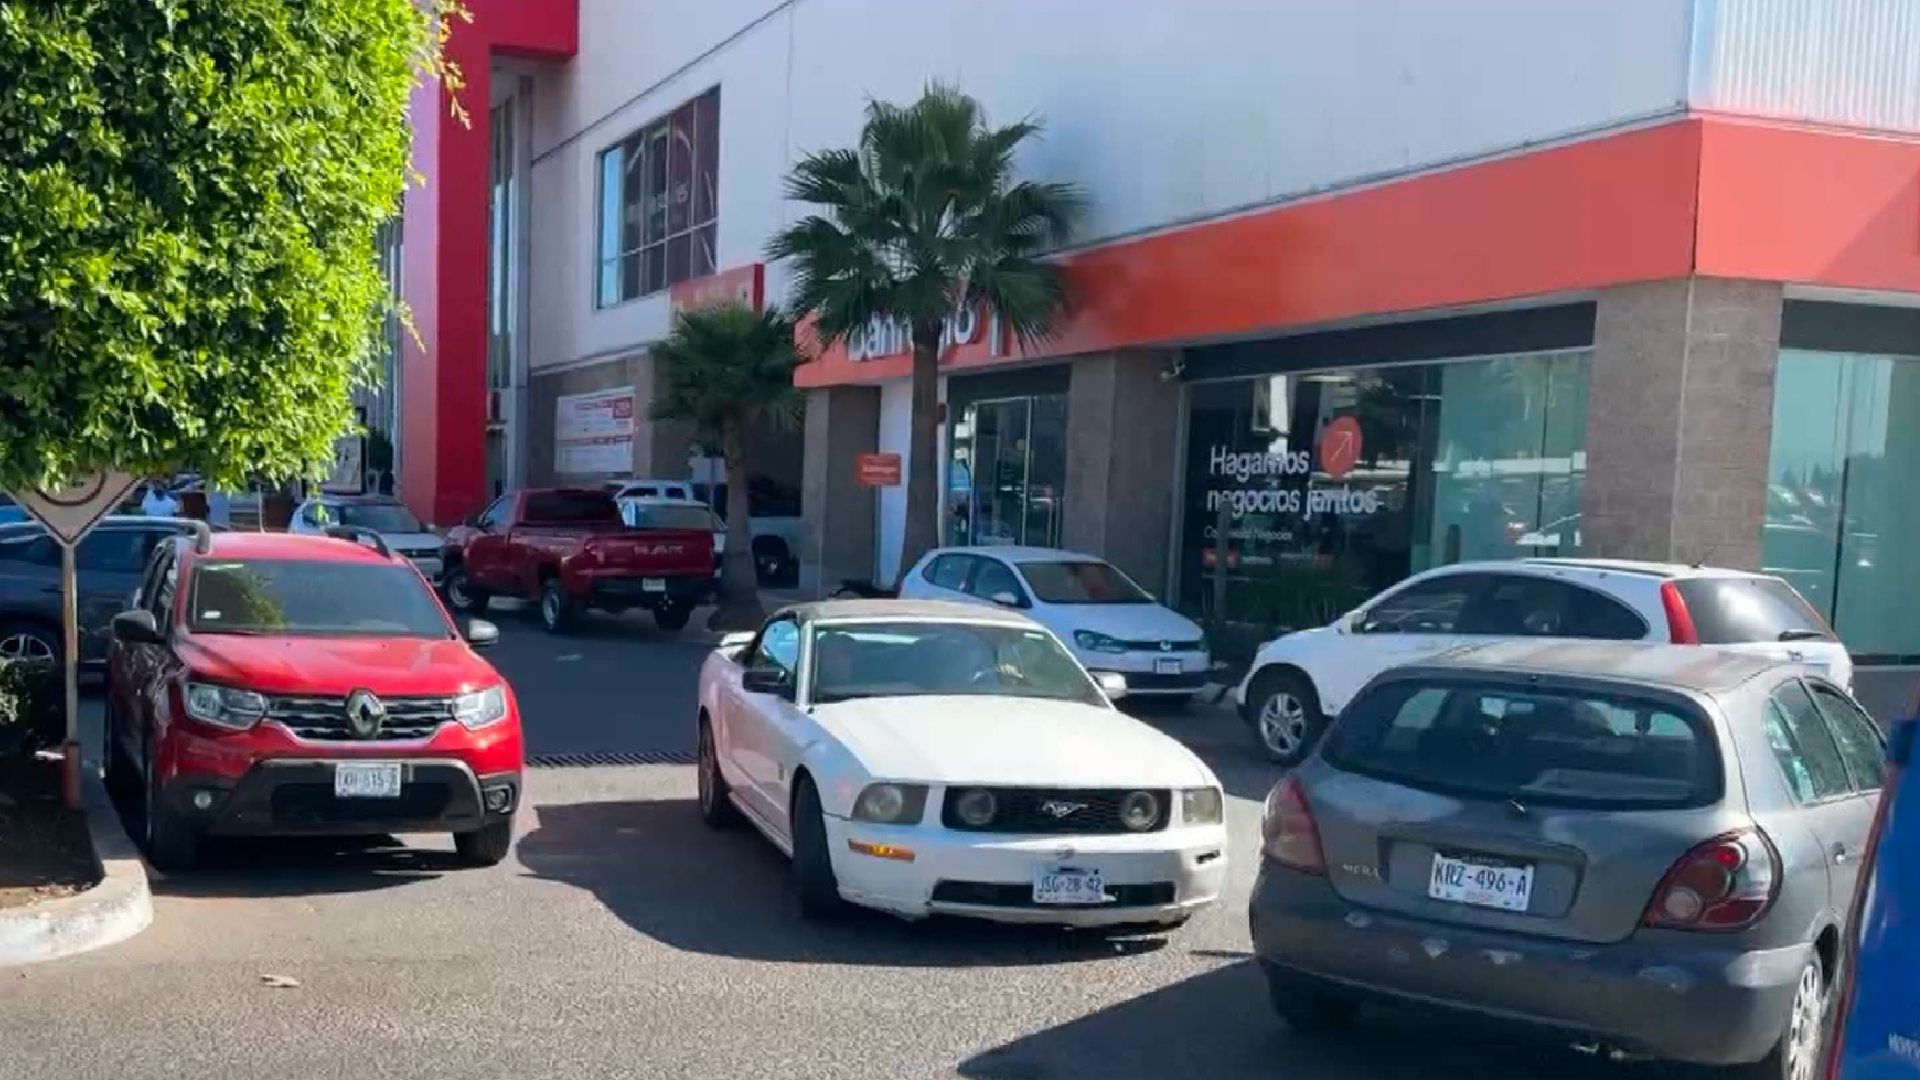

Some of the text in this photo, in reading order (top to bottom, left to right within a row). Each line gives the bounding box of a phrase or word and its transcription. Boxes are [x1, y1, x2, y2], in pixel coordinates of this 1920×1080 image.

[1209, 445, 1309, 482] Hagamos
[1207, 480, 1379, 521] negocios juntos
[1433, 861, 1527, 898] KRZ-496-A
